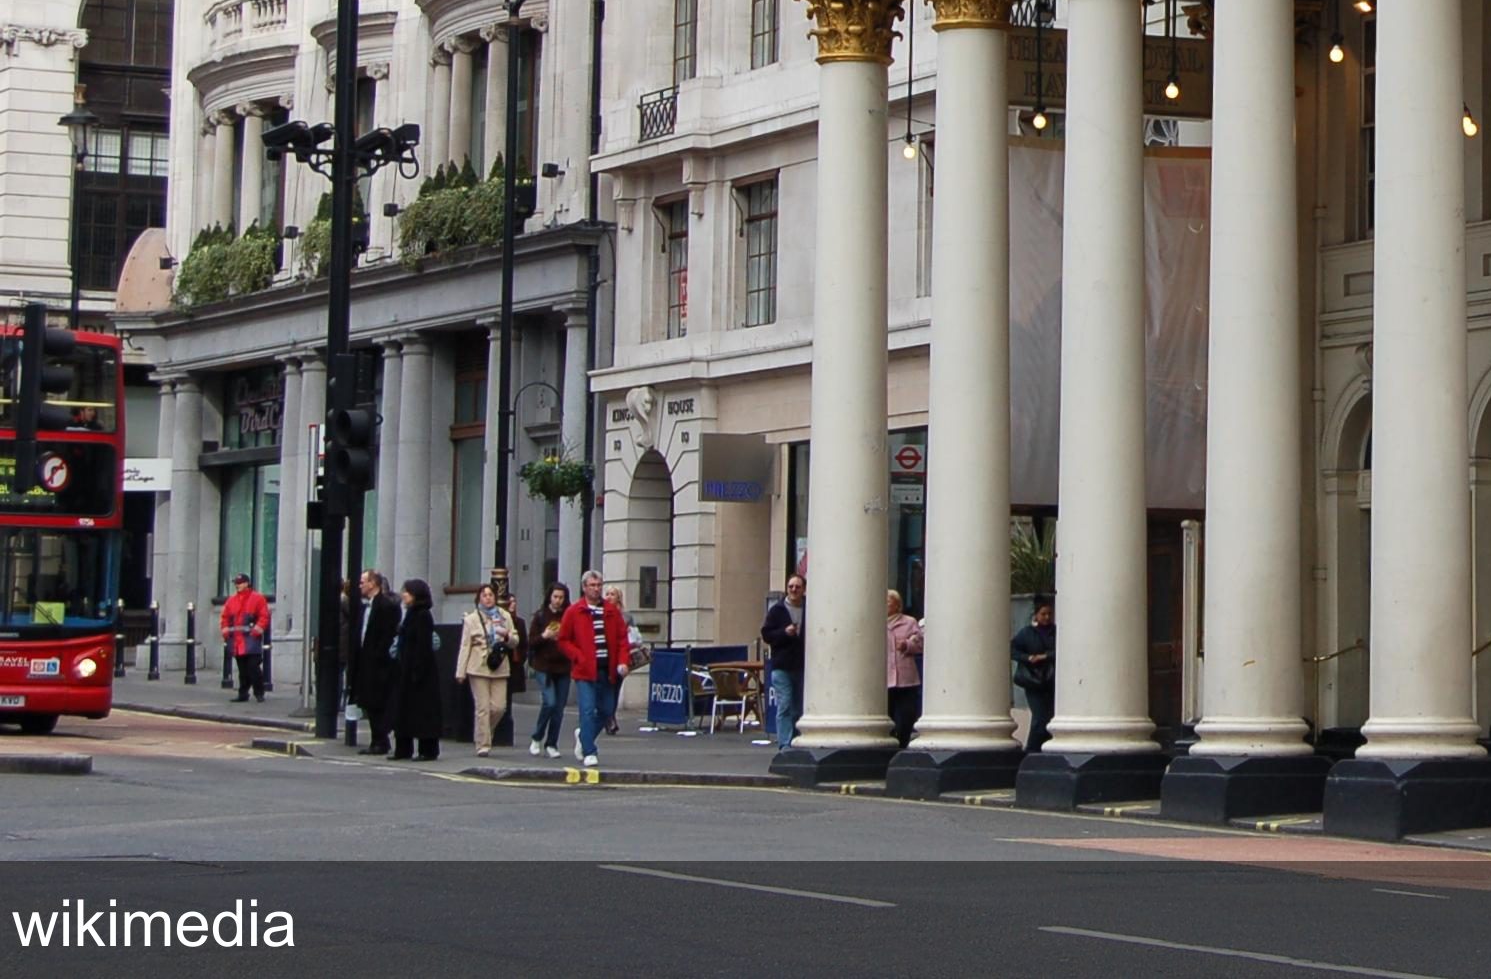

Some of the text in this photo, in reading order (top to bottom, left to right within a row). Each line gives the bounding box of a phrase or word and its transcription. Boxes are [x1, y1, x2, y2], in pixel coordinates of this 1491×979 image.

[612, 399, 695, 422] KING HOUSE
[651, 682, 684, 704] PREZZO
